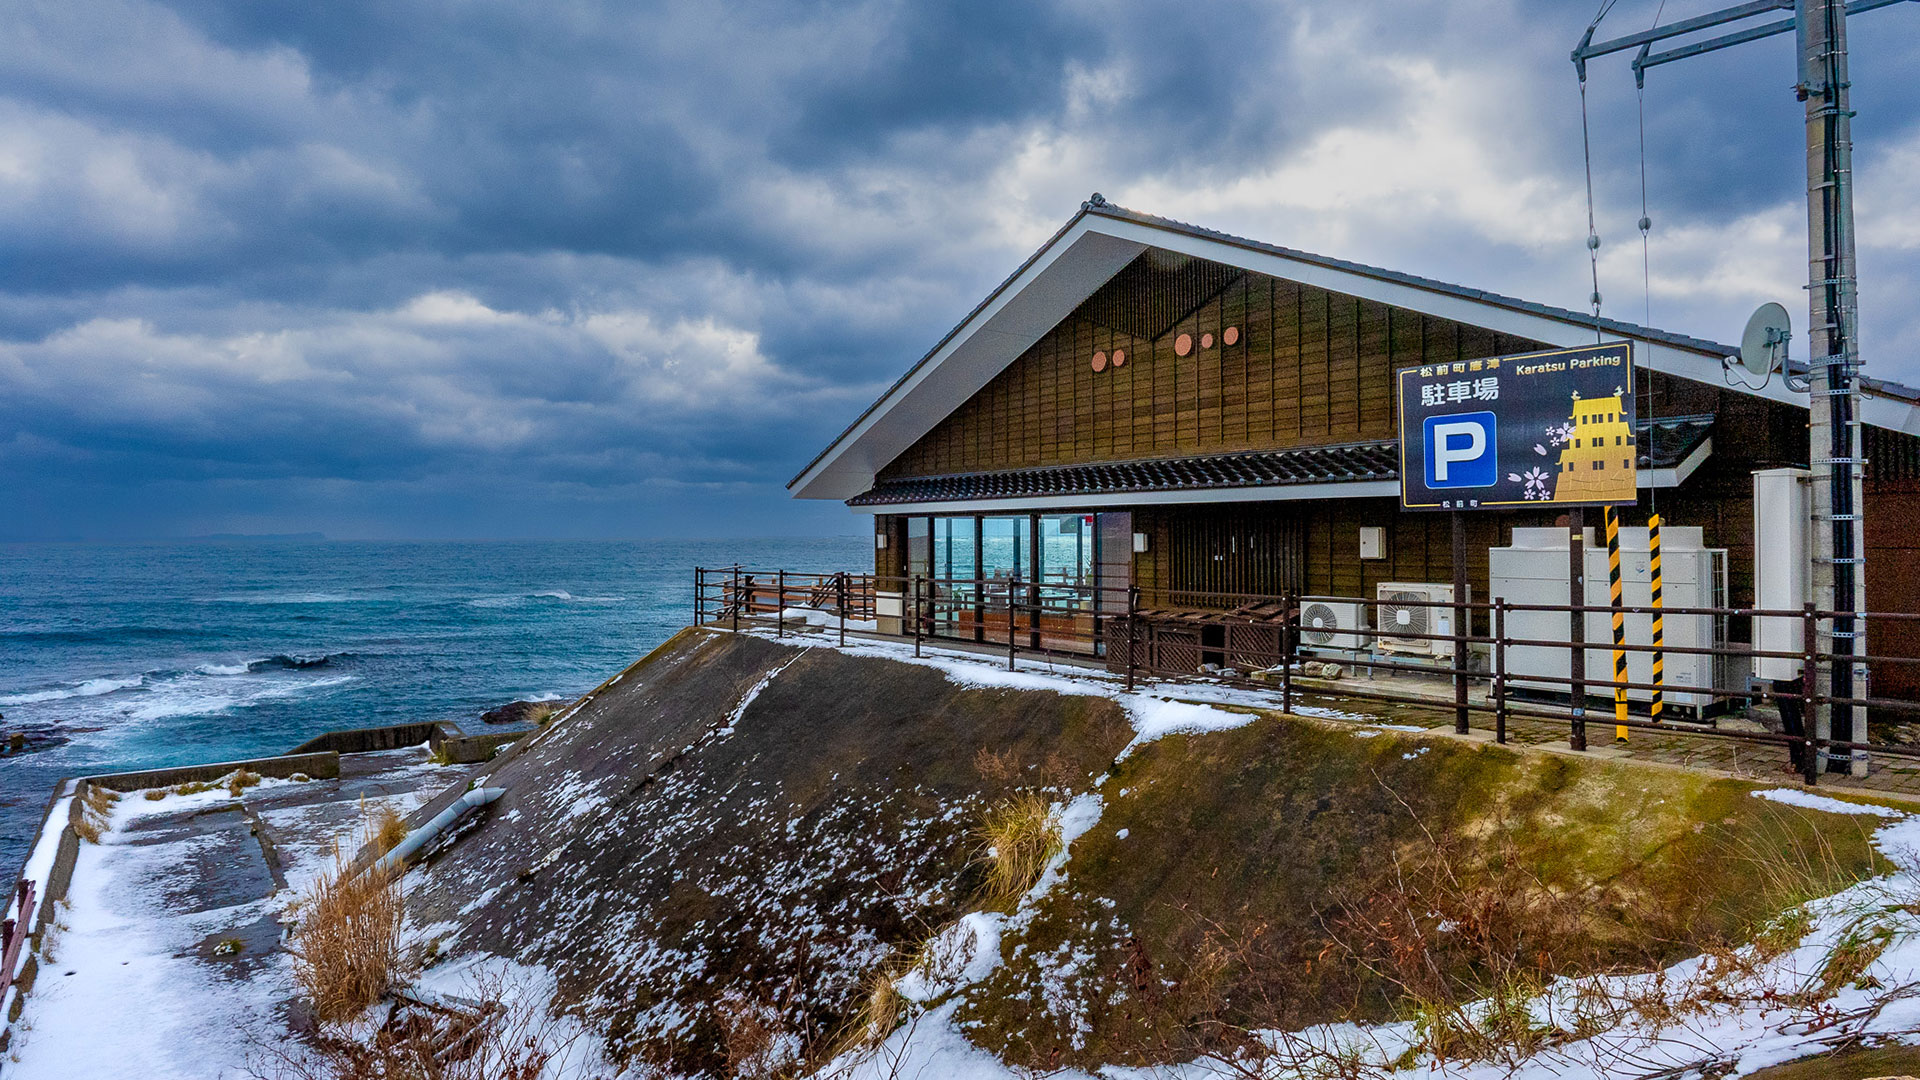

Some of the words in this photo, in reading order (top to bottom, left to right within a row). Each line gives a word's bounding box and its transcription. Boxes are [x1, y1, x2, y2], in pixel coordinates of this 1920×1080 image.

[1420, 358, 1500, 377] 松前町唐津
[1516, 361, 1565, 375] Karatsu
[1570, 355, 1621, 370] Parking
[1421, 377, 1500, 407] 駐車場
[1434, 421, 1487, 481] P
